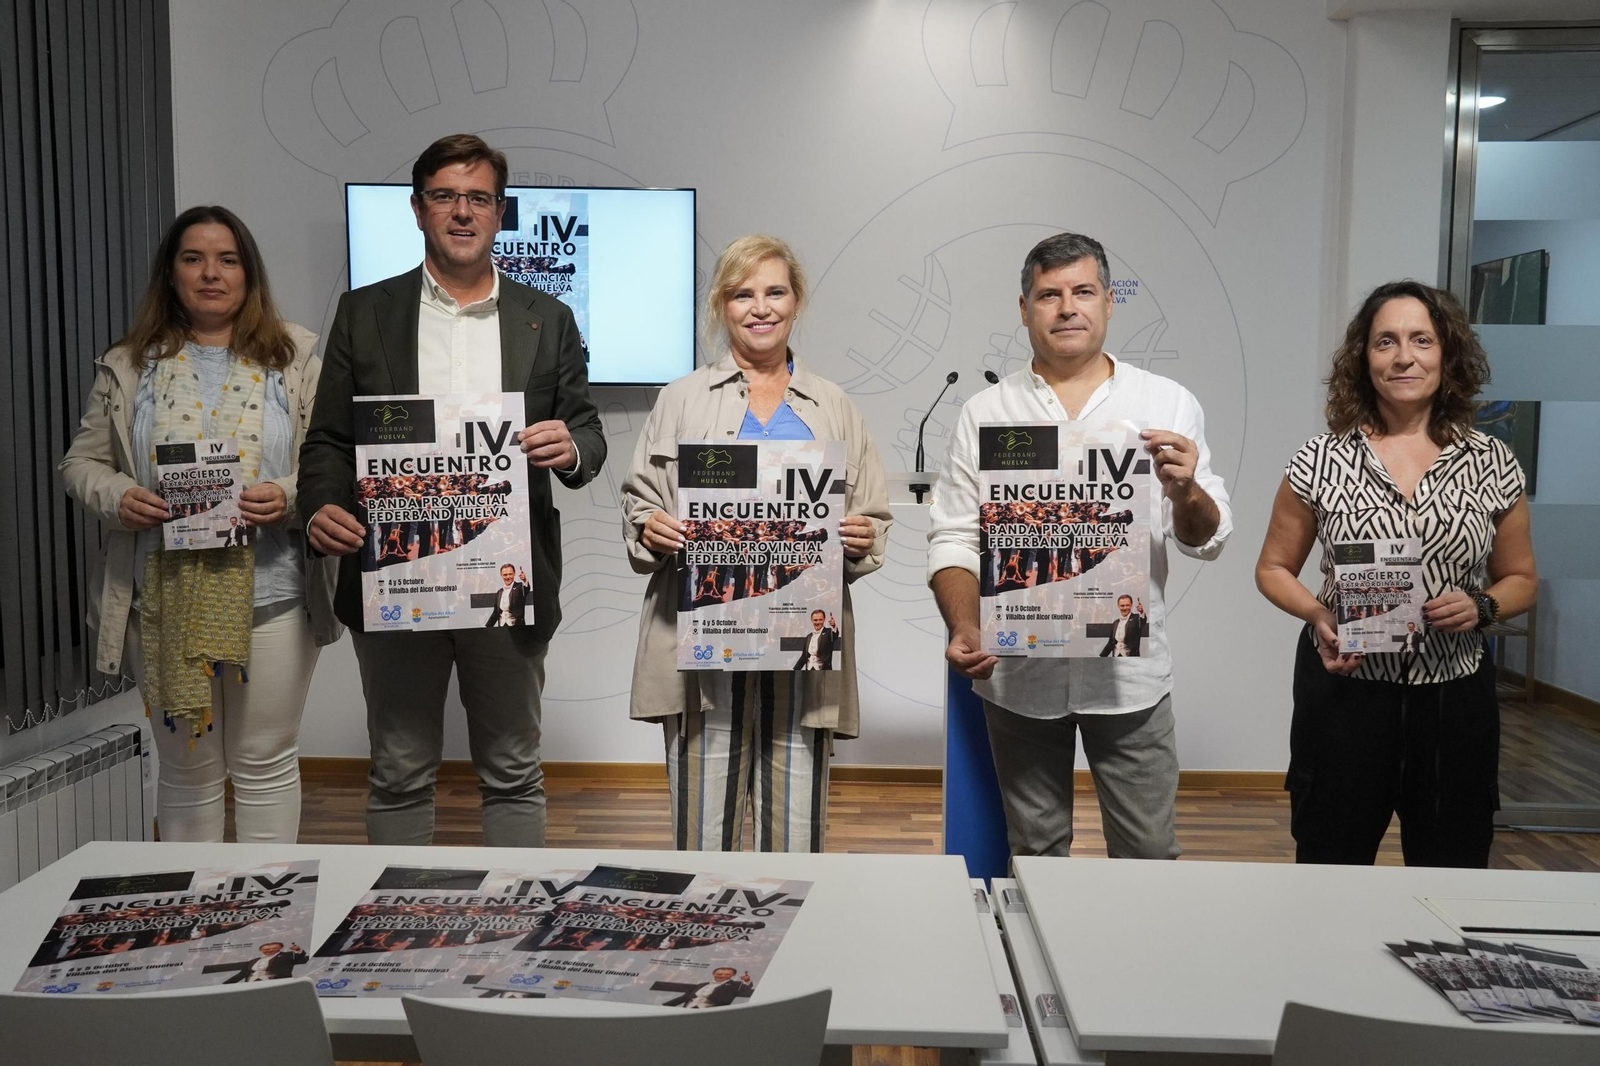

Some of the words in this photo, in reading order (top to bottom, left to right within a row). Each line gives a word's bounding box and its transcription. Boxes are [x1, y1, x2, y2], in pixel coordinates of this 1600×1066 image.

[542, 216, 577, 243] IV
[492, 242, 576, 255] CUENTRO
[1111, 278, 1138, 287] ACIÓN
[465, 421, 512, 456] IV
[210, 443, 223, 453] IV
[368, 454, 512, 476] ENCUENTRO
[1088, 448, 1136, 484] IV
[163, 469, 230, 480] CONCIERTO
[165, 478, 230, 487] EXTRAORDINARIO
[786, 468, 833, 503] IV
[990, 482, 1134, 501] ENCUENTRO
[368, 497, 422, 510] BANDA
[423, 494, 508, 508] PROVINCIAL
[688, 502, 830, 519] ENCUENTRO
[369, 509, 450, 522] FEDERBAND
[456, 506, 509, 518] HUELVA
[989, 524, 1041, 535] BANDA
[1043, 524, 1128, 534] PROVINCIAL
[688, 542, 738, 552] BANDA
[740, 542, 823, 552] PROVINCIAL
[989, 537, 1070, 548] FEDERBAND
[1075, 536, 1129, 547] HUELVA
[1391, 544, 1404, 554] IV
[687, 554, 766, 564] FEDERBAND
[771, 554, 823, 564] HUELVA
[1340, 572, 1410, 581] CONCIERTO
[231, 872, 300, 891] IV
[516, 881, 580, 897] IV
[78, 888, 294, 913] ENCUENTRO
[578, 893, 774, 917] ENCUENTRO
[718, 889, 790, 908] IV
[62, 921, 193, 937] FEDERBAND
[200, 914, 282, 924] HUELVA
[66, 919, 142, 930] BANDA
[151, 907, 282, 922] PROVINCIAL
[561, 912, 627, 924] BANDA
[634, 920, 753, 934] PROVINCIAL
[556, 919, 669, 935] FEDERBAND
[673, 929, 750, 941] HUELVA
